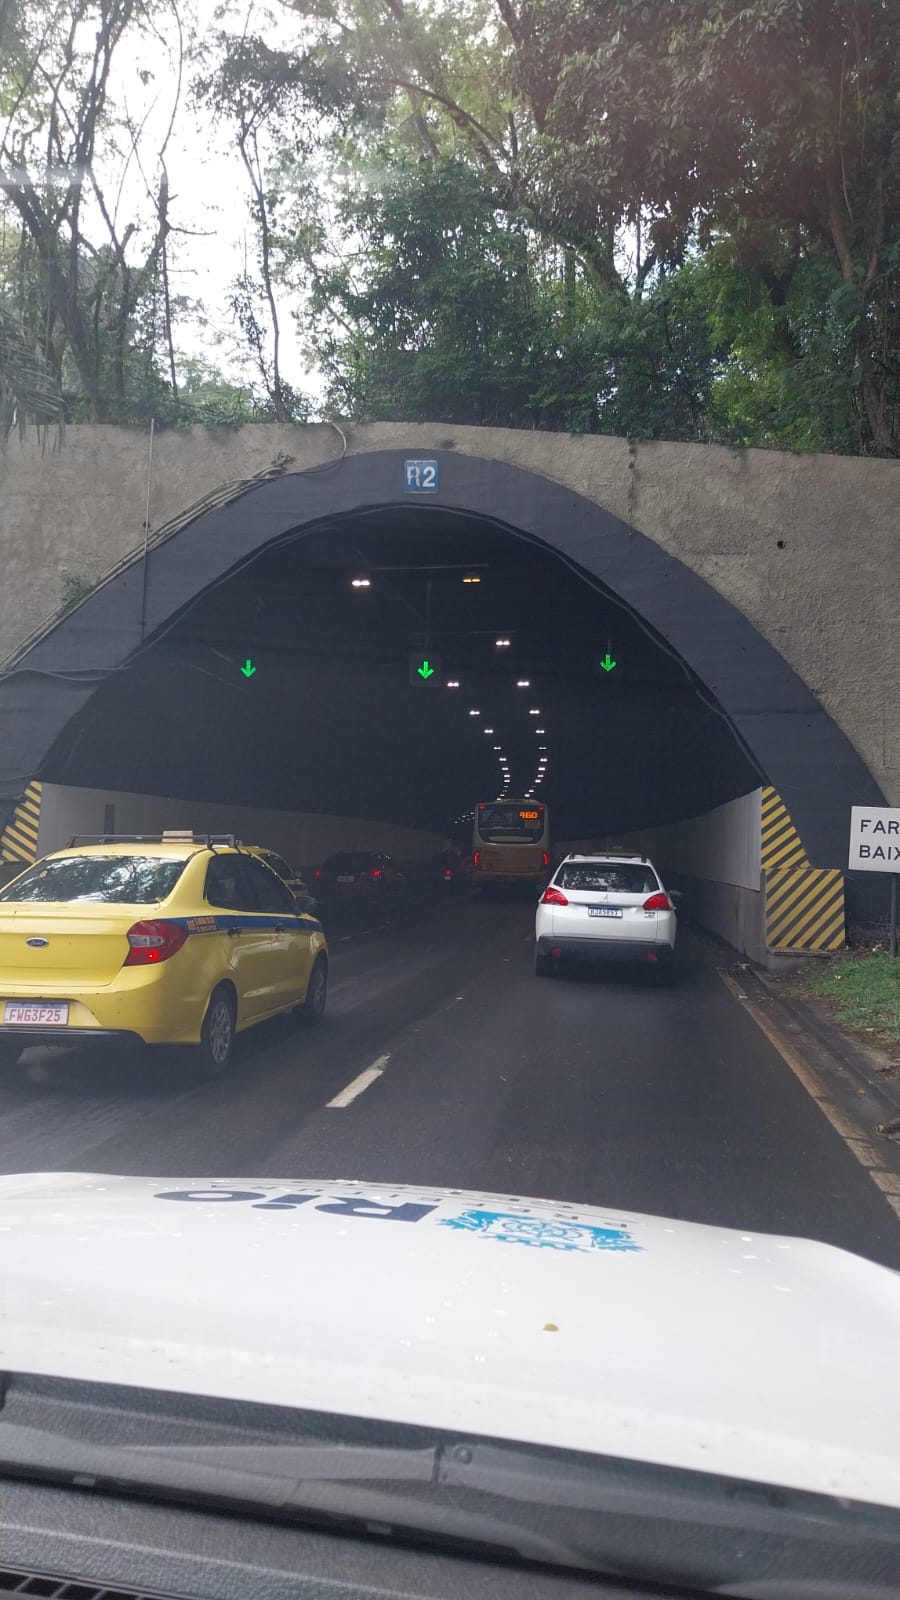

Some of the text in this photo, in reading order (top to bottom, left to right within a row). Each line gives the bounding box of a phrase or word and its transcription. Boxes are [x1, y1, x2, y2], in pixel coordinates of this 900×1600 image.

[407, 465, 436, 487] R2
[860, 819, 900, 834] FAR
[9, 1009, 61, 1022] FWG3F25
